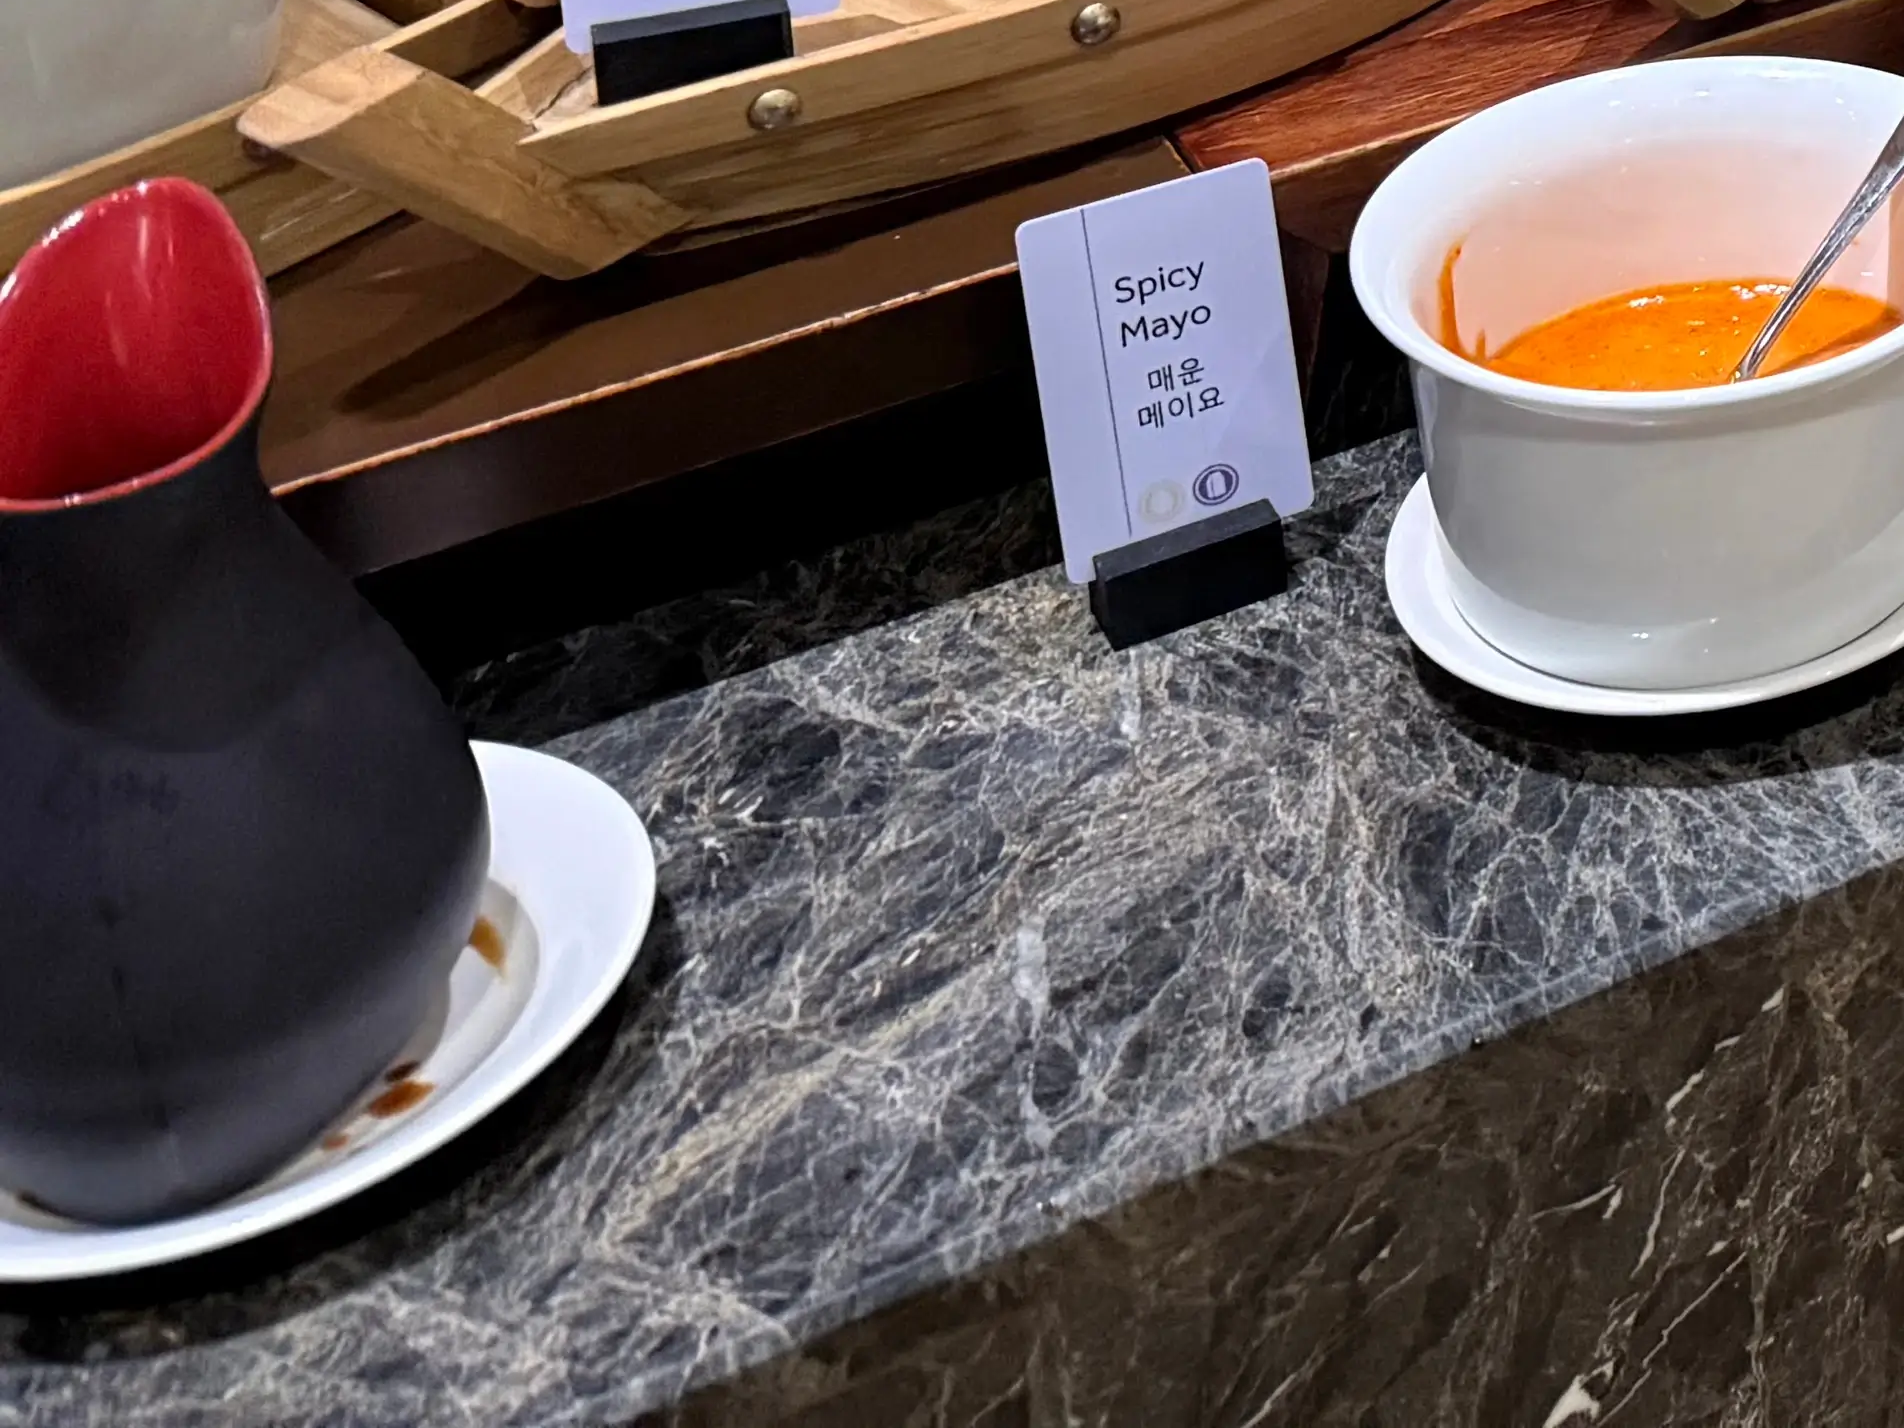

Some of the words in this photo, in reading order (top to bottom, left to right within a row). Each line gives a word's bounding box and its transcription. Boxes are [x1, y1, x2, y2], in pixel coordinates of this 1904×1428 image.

[1114, 261, 1206, 306] Spicy
[1121, 305, 1212, 348] Mayo
[1147, 357, 1205, 394] 매운
[1137, 387, 1225, 430] 메이요
